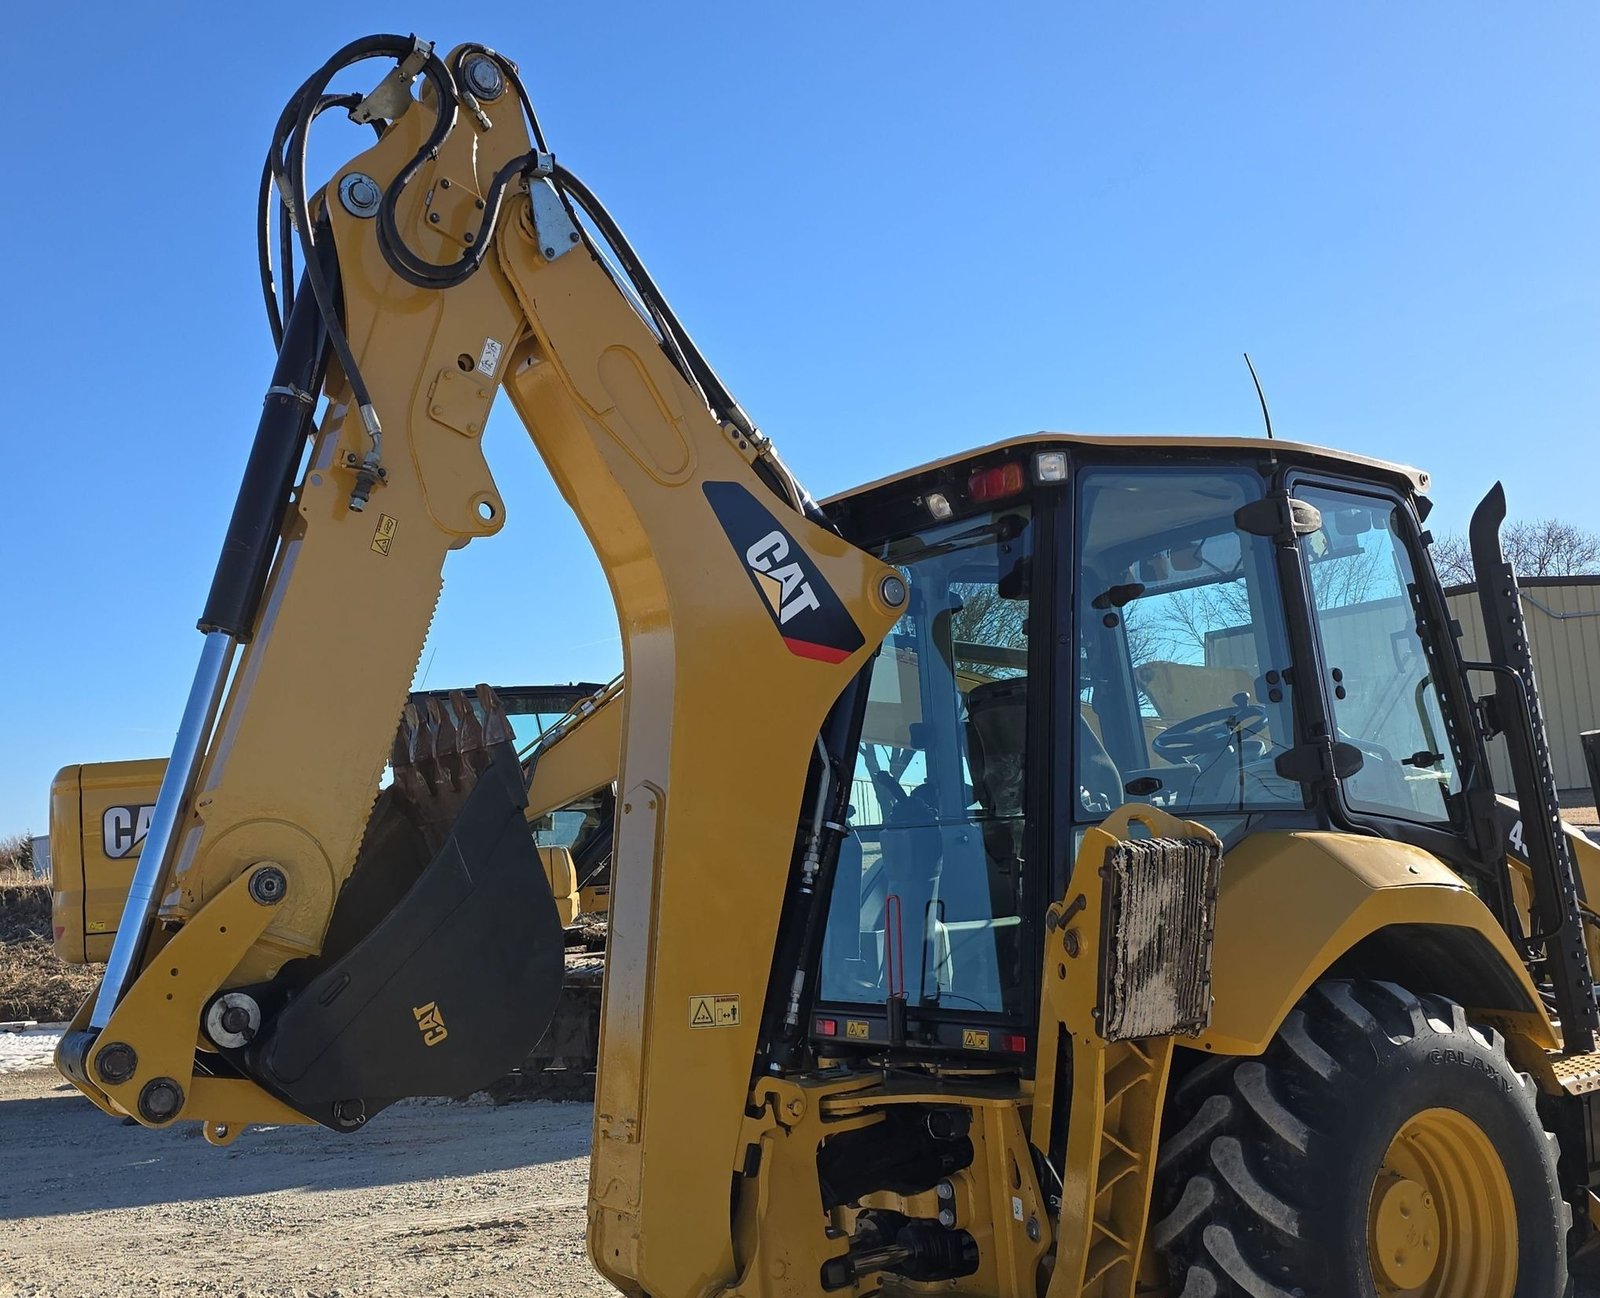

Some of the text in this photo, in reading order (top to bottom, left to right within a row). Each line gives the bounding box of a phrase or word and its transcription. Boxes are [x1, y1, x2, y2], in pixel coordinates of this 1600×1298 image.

[746, 530, 820, 625] CAT
[104, 806, 156, 857] CA
[413, 1001, 448, 1046] CAT
[1428, 1047, 1513, 1094] GALAXY
